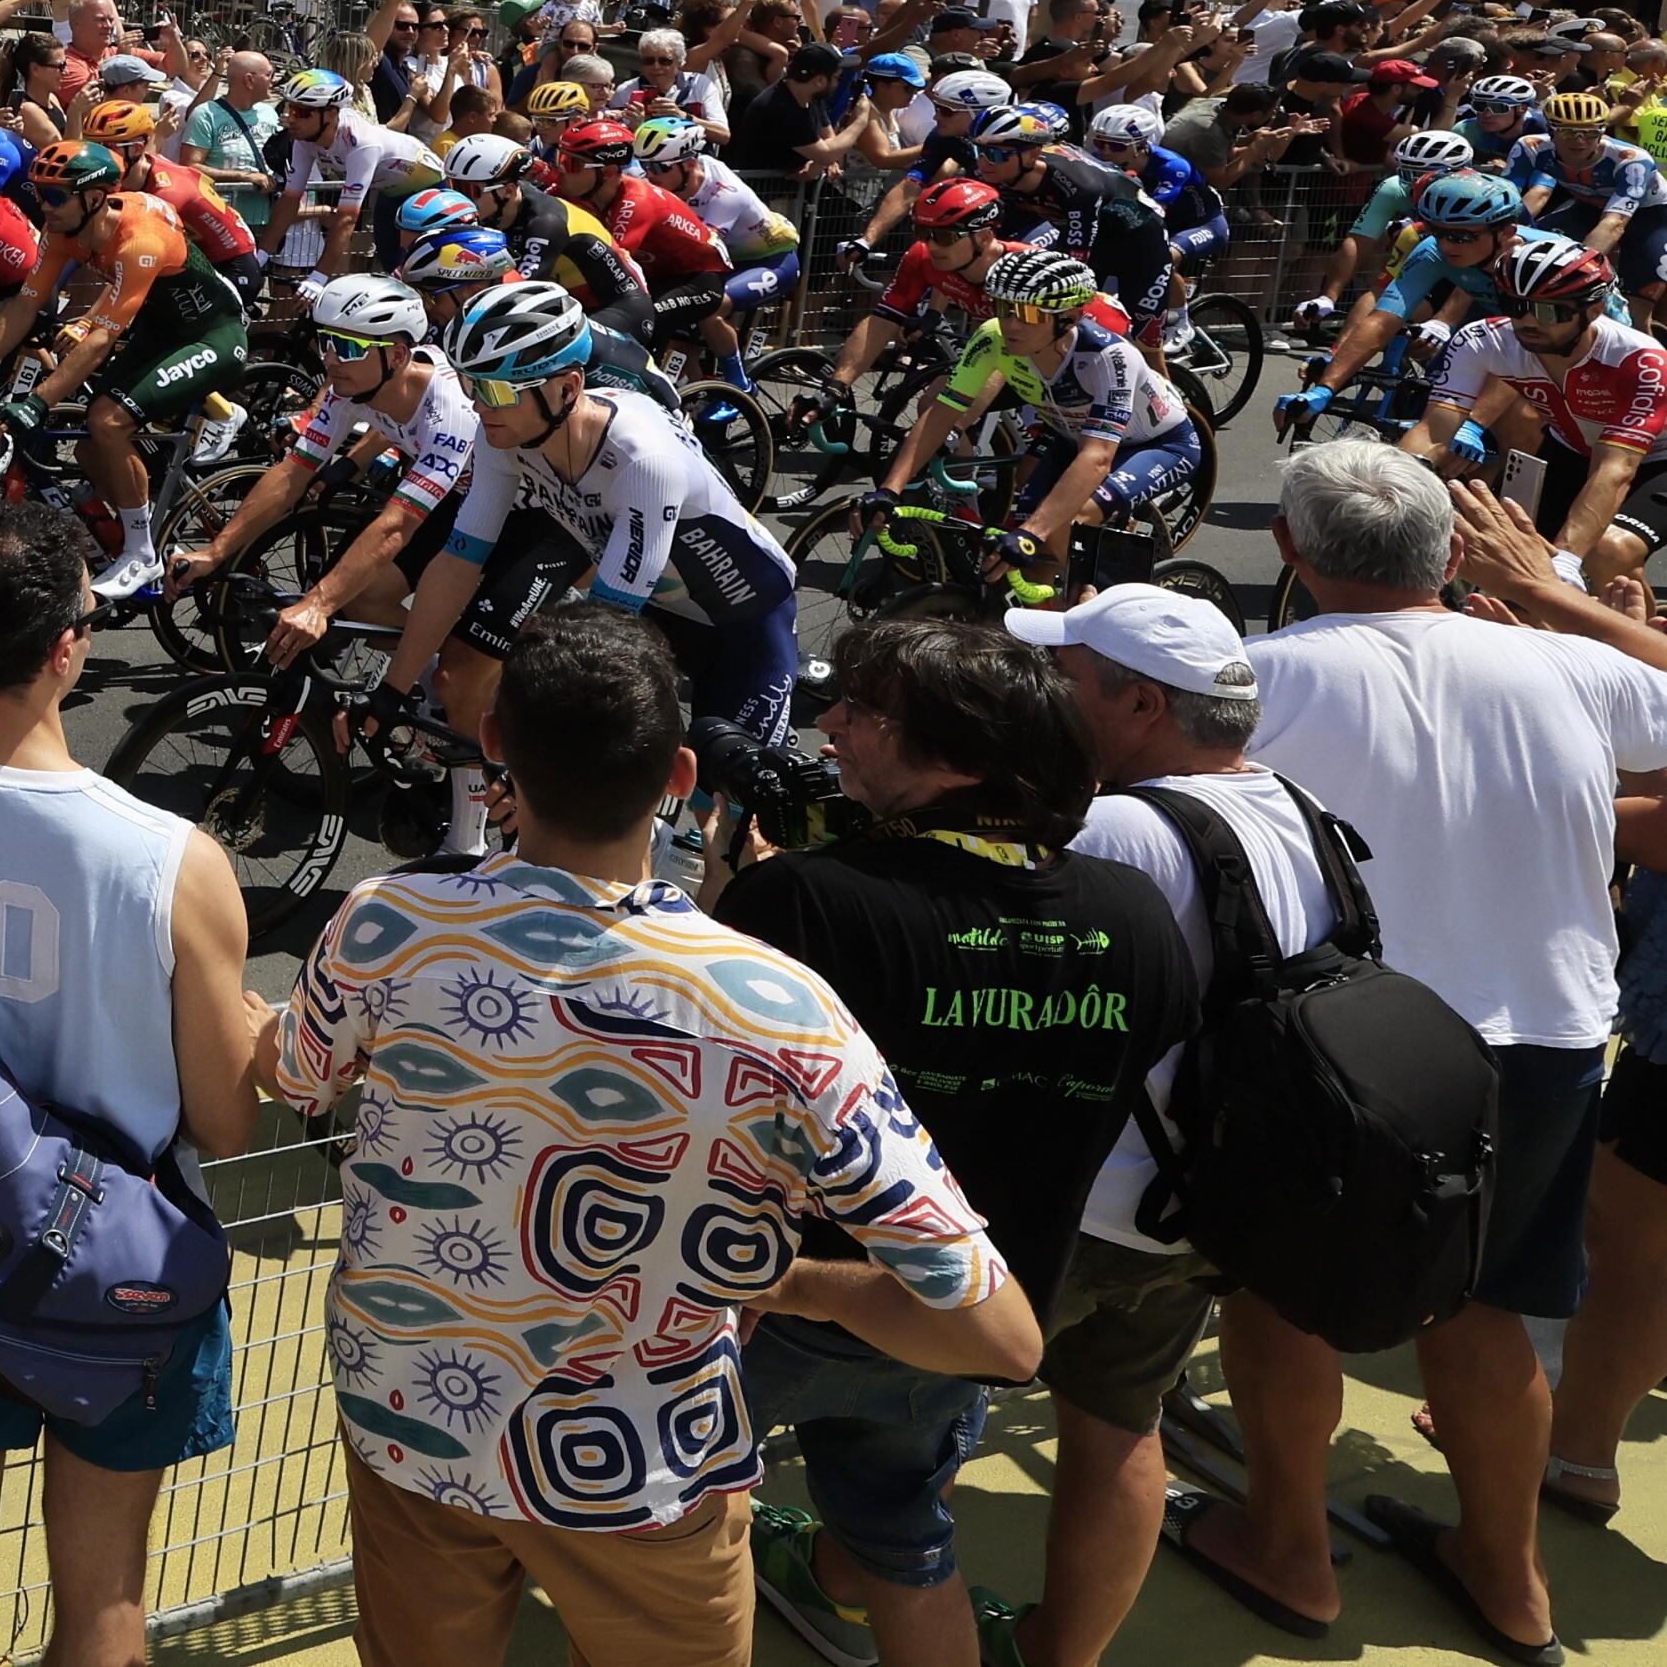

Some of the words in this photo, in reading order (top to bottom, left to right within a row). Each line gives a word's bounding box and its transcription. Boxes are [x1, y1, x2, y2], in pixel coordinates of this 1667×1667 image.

[77, 165, 107, 185] GIANT
[616, 199, 636, 242] ARKE
[668, 213, 701, 240] ARKEA
[1067, 210, 1082, 246] BOSS
[110, 261, 123, 306] GIANT
[436, 267, 493, 279] SPECIALIZED
[602, 254, 625, 284] SOLAR
[1137, 262, 1173, 311] BORA
[749, 334, 762, 355] 218
[20, 363, 38, 388] 161
[156, 349, 218, 388] Jayco
[512, 357, 559, 377] RUDY
[667, 355, 683, 376] 163
[1110, 348, 1127, 388] Wallonie
[289, 373, 316, 397] SWISS
[1622, 353, 1666, 427] Cofidis
[111, 388, 147, 420] CADEX
[1130, 456, 1195, 510] FANTINI
[1614, 513, 1660, 543] ORIMA
[620, 507, 643, 584] MERIDA
[679, 528, 758, 605] BAHRAIN
[469, 621, 512, 652] Emir
[274, 718, 292, 749] Emirates
[1034, 934, 1064, 944] UISP
[921, 984, 1129, 1032] LAVURADÔR
